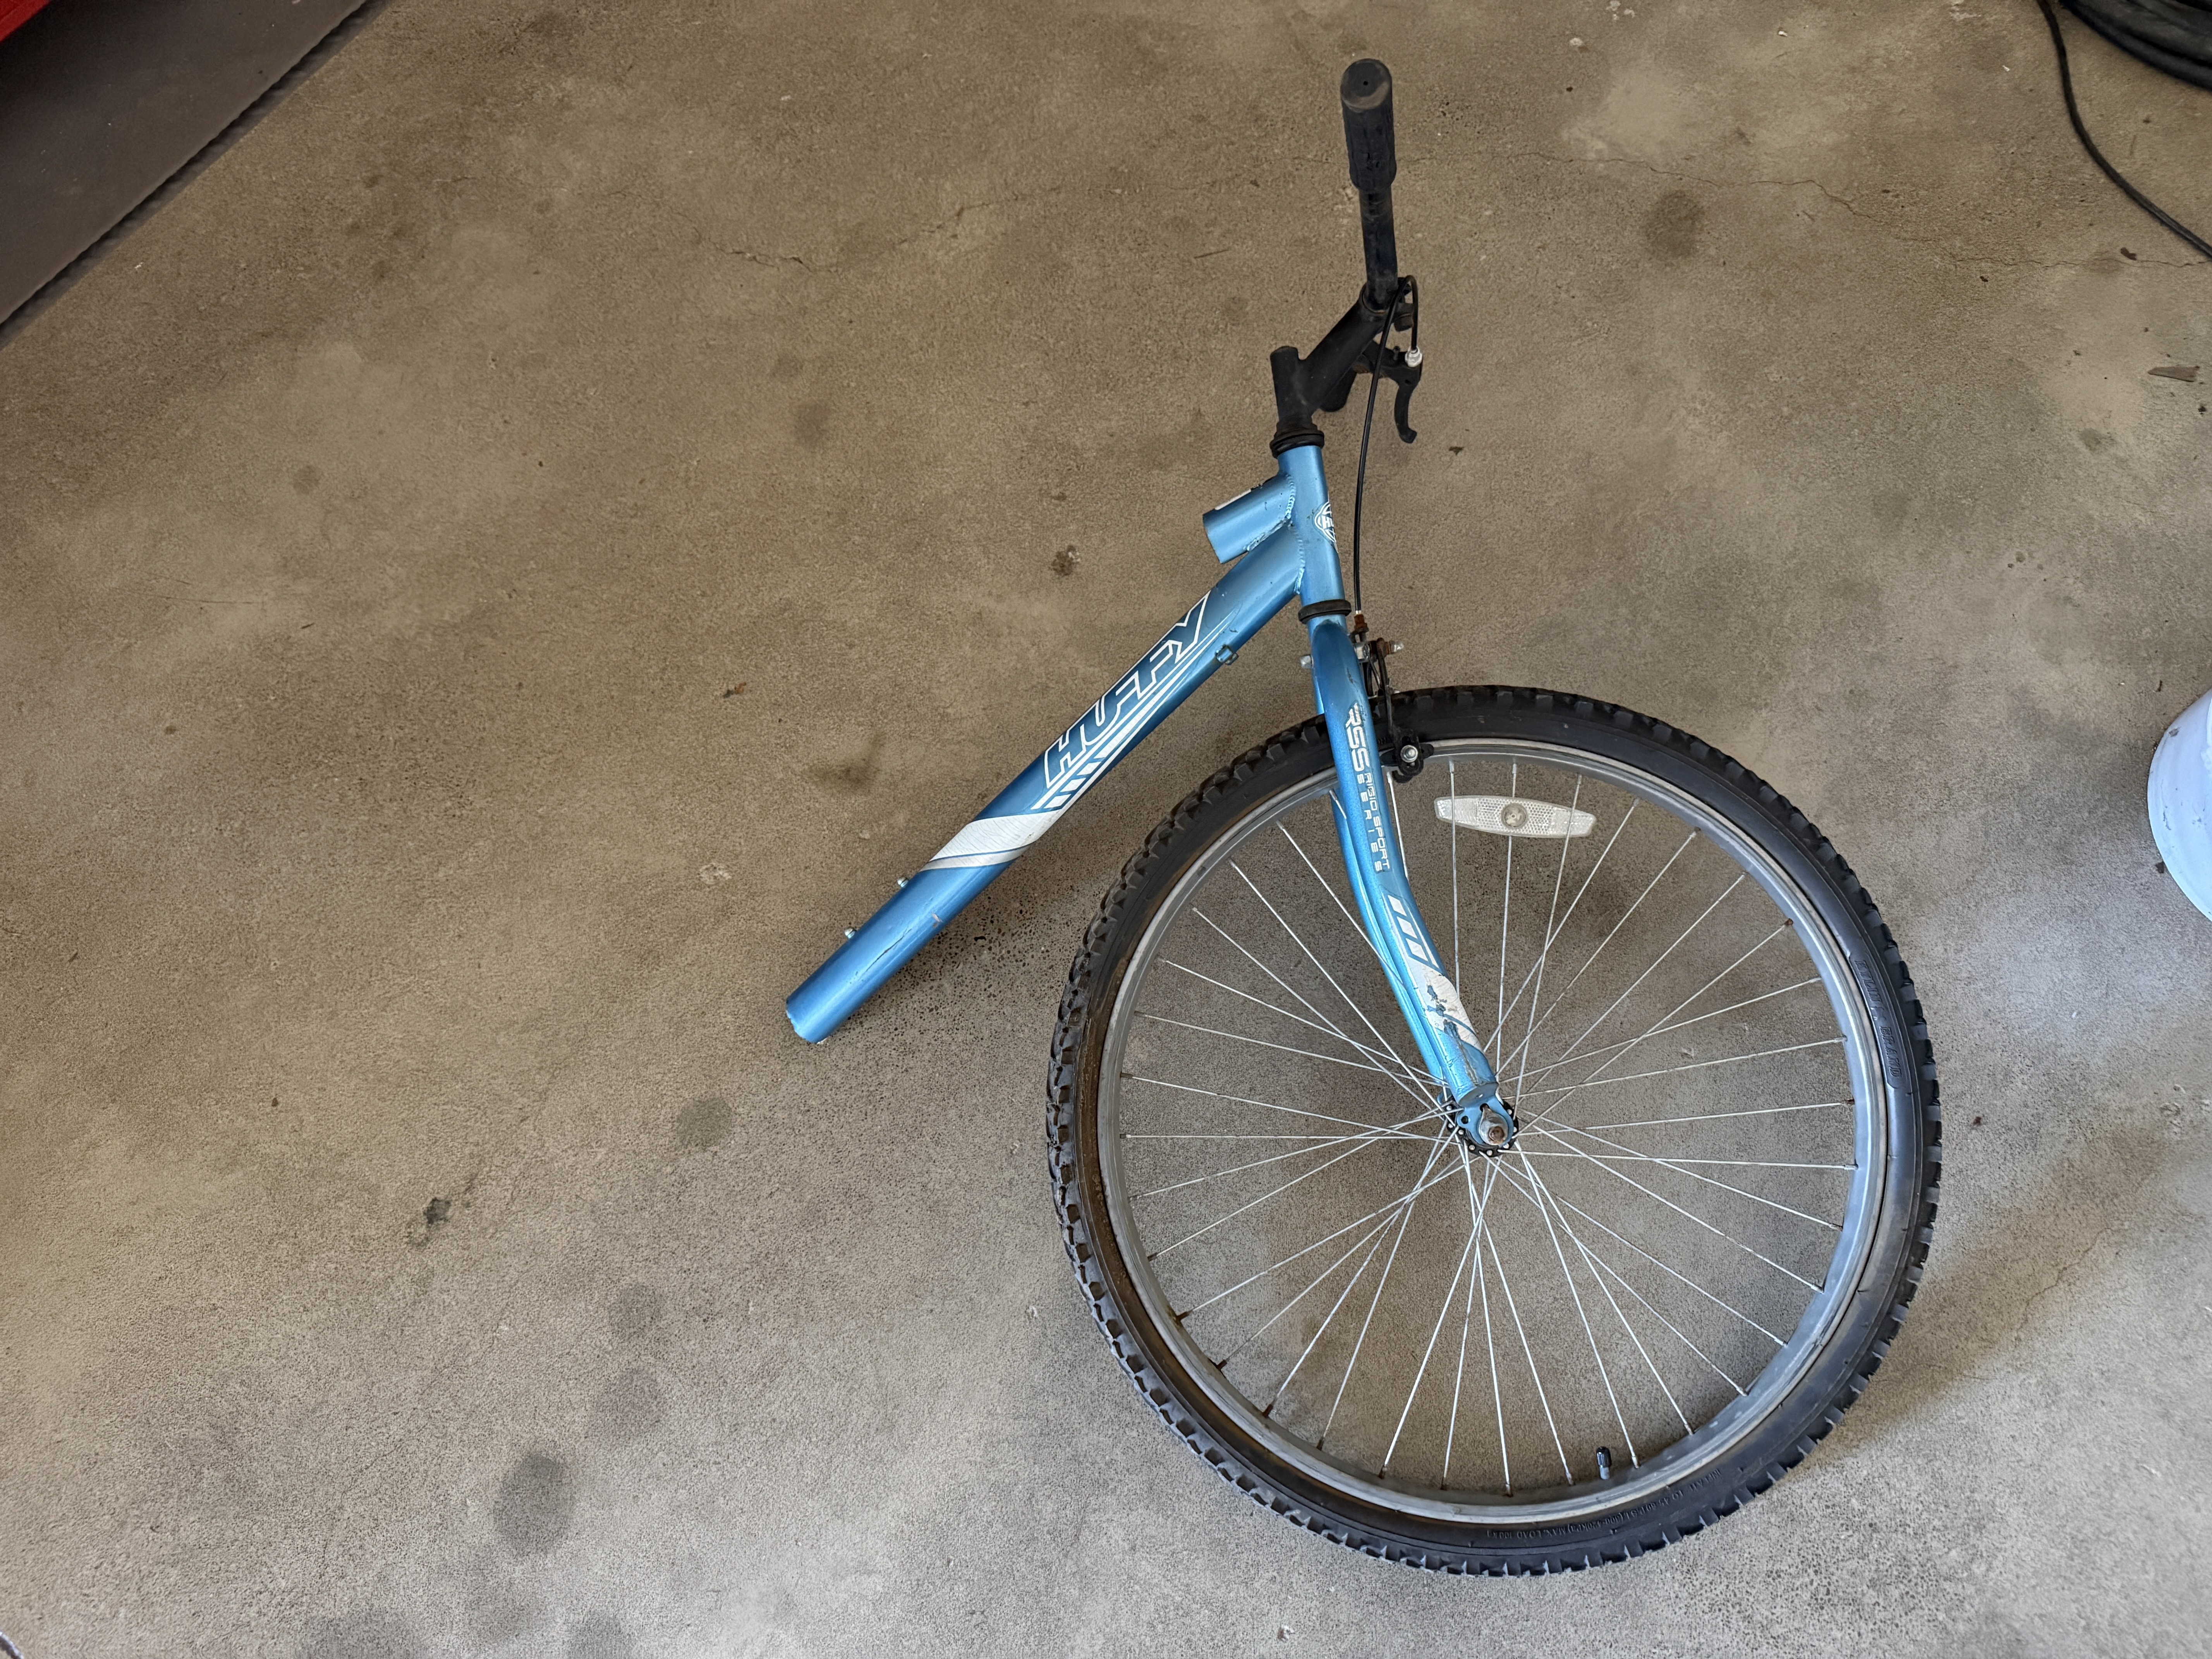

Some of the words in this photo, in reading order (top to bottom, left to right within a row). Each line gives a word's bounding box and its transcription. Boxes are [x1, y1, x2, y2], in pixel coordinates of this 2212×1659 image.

[1044, 590, 1211, 788] HUFFY
[1345, 702, 1370, 772] RSS
[1357, 774, 1382, 872] SERIES
[1364, 772, 1377, 811] RIGID
[1373, 816, 1390, 869] SPORT
[1879, 1025, 1902, 1077] BRAND
